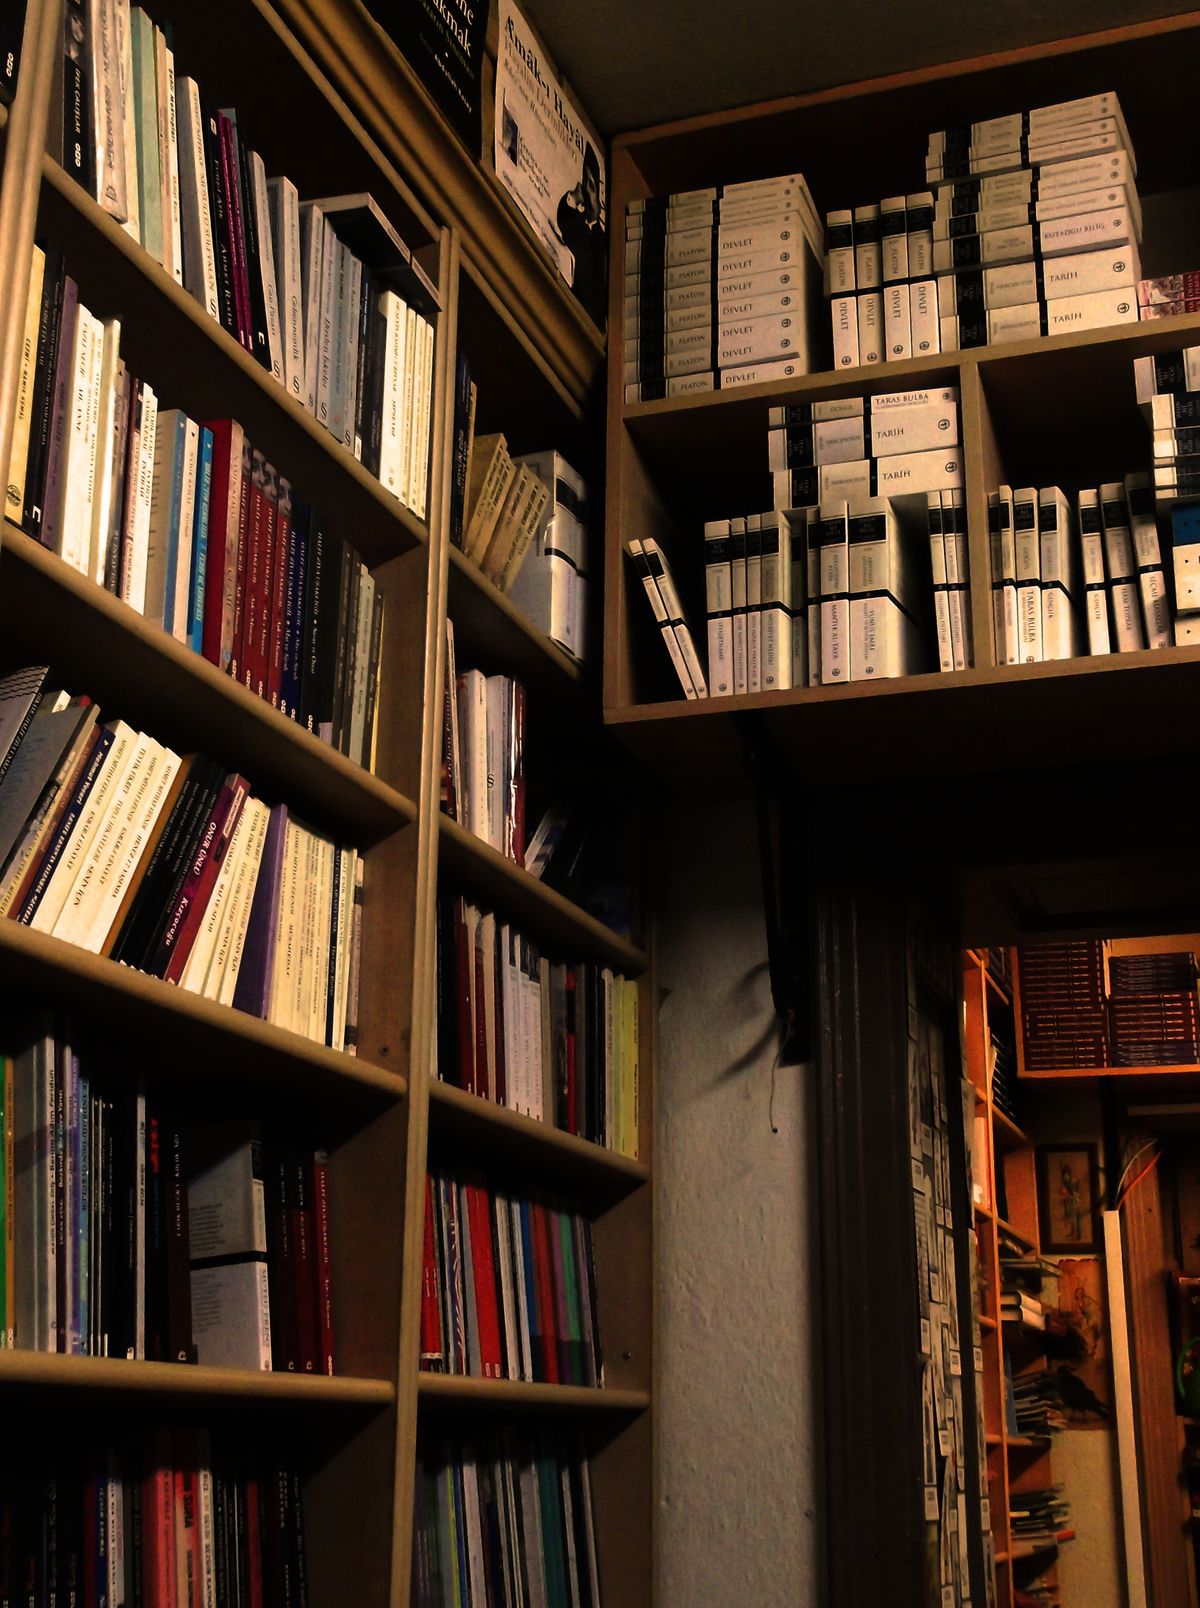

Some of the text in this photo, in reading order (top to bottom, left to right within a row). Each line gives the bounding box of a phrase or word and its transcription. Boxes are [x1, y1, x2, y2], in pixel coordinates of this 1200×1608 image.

[722, 239, 752, 249] DEVLET
[722, 260, 752, 271] DEVLET
[1049, 271, 1078, 283] TARİH
[722, 282, 752, 293] DEVLET
[893, 290, 901, 319] DEVLET
[918, 286, 927, 315] DEVLET
[722, 304, 753, 315] DEVLET
[866, 298, 874, 327] DEVLET
[840, 302, 849, 331] DEVLET
[1052, 312, 1082, 324] TARİH
[722, 326, 753, 337] DEVLET
[722, 347, 752, 358] DEVLET
[725, 373, 756, 383] DEVLET
[876, 428, 904, 439] TARİH
[883, 470, 911, 481] TARİH
[192, 820, 218, 876] ONUR ÜNLÜ
